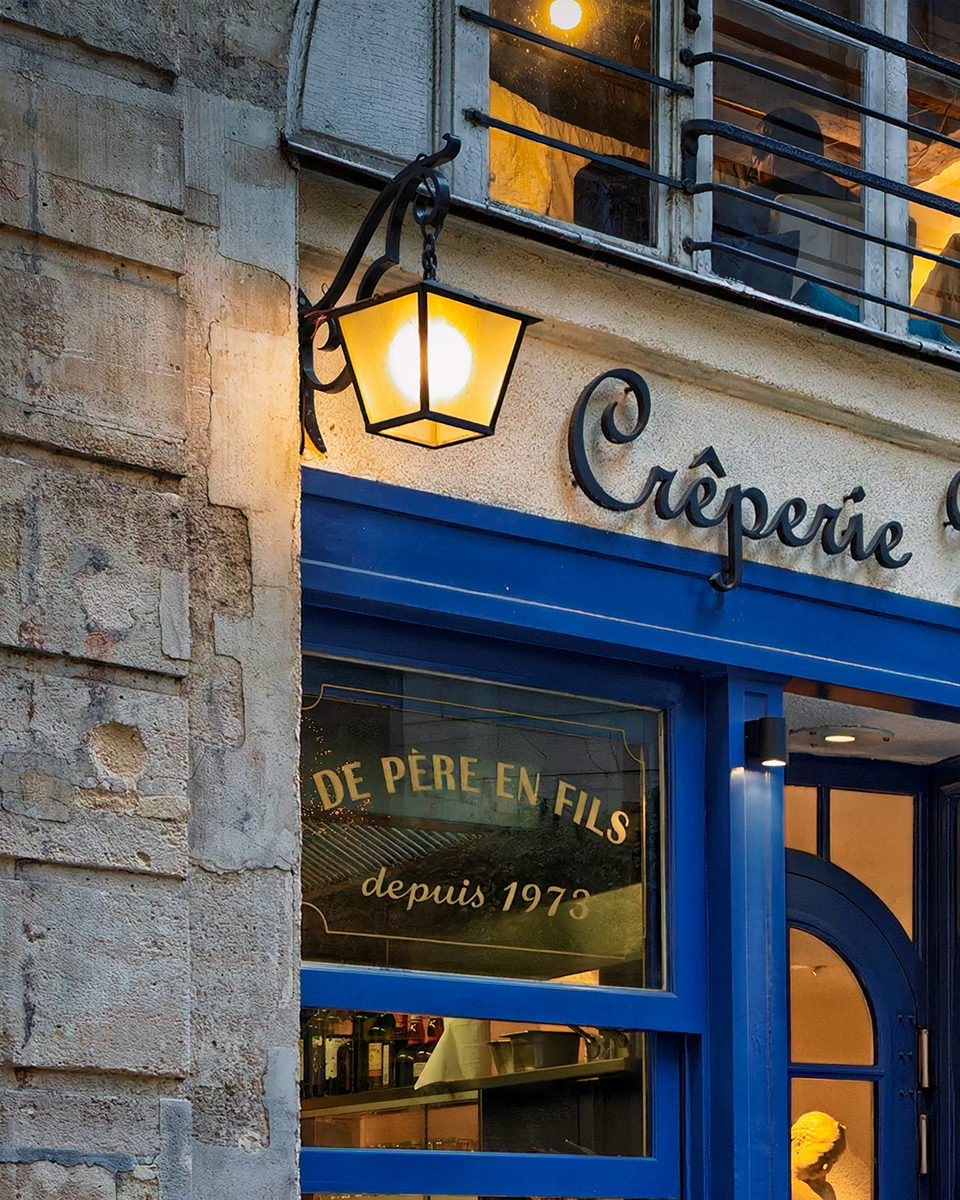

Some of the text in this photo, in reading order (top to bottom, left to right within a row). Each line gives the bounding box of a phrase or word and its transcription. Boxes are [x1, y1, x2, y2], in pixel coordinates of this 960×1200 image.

[567, 368, 912, 593] Crêperie
[312, 748, 630, 845] DE PÈRE EN FILS
[361, 866, 592, 920] depuis 1973
